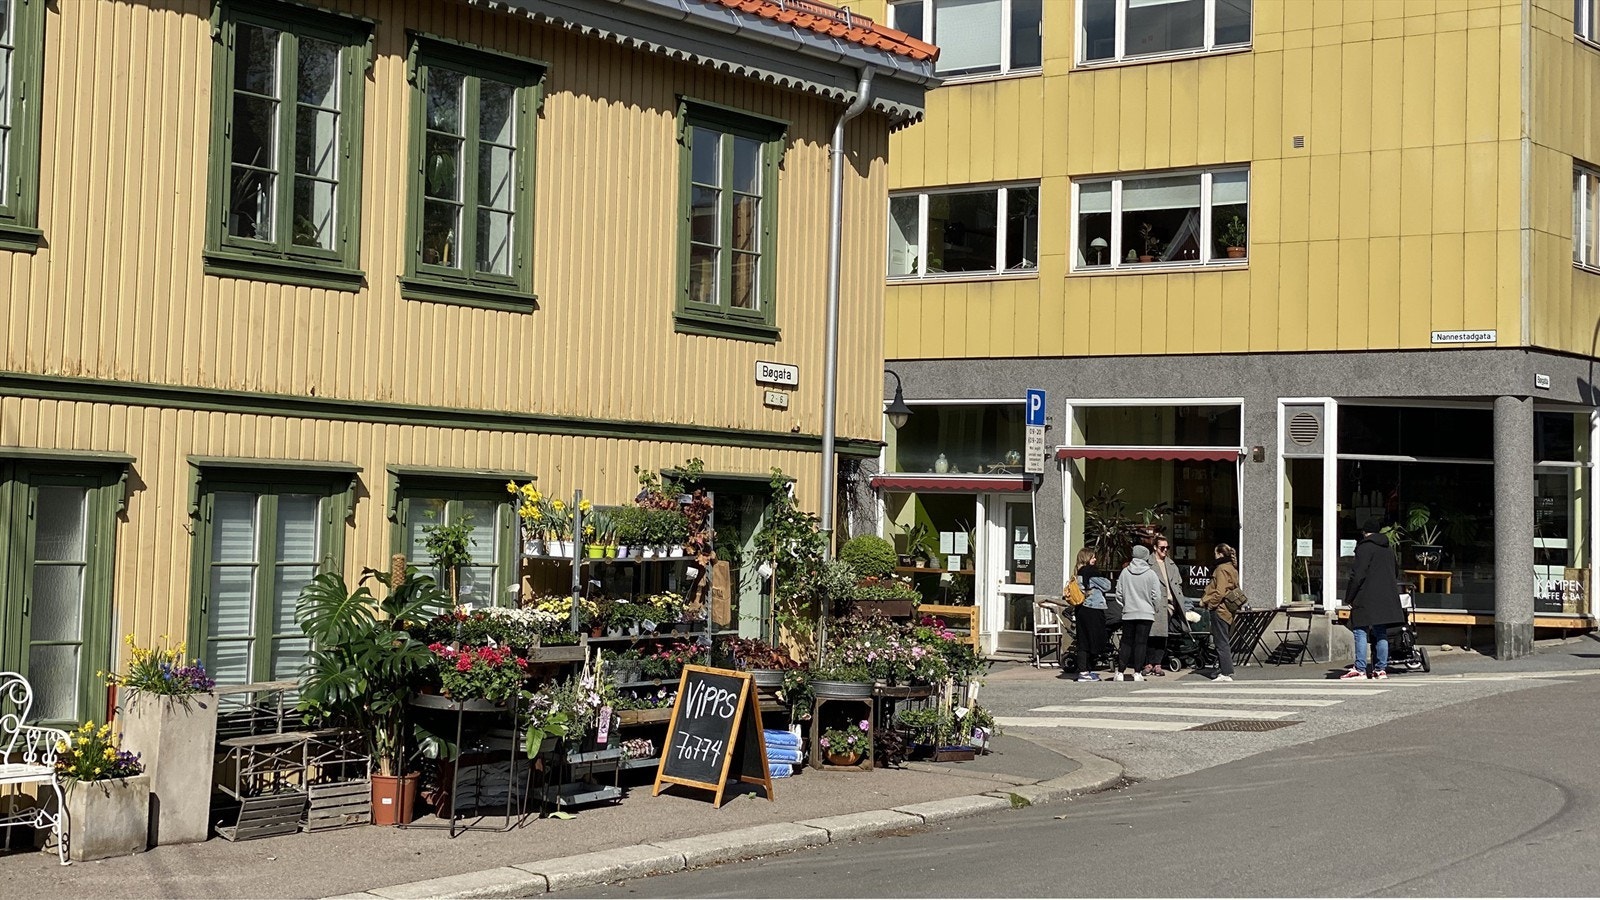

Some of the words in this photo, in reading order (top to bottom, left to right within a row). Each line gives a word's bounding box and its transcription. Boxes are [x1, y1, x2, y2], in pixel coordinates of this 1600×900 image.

[1436, 333, 1491, 342] Nannestadgata
[762, 365, 792, 382] Bøgata
[1030, 393, 1042, 421] P
[1537, 579, 1585, 591] KAMPEN
[1537, 592, 1560, 600] KAFFE
[1562, 592, 1568, 601] &
